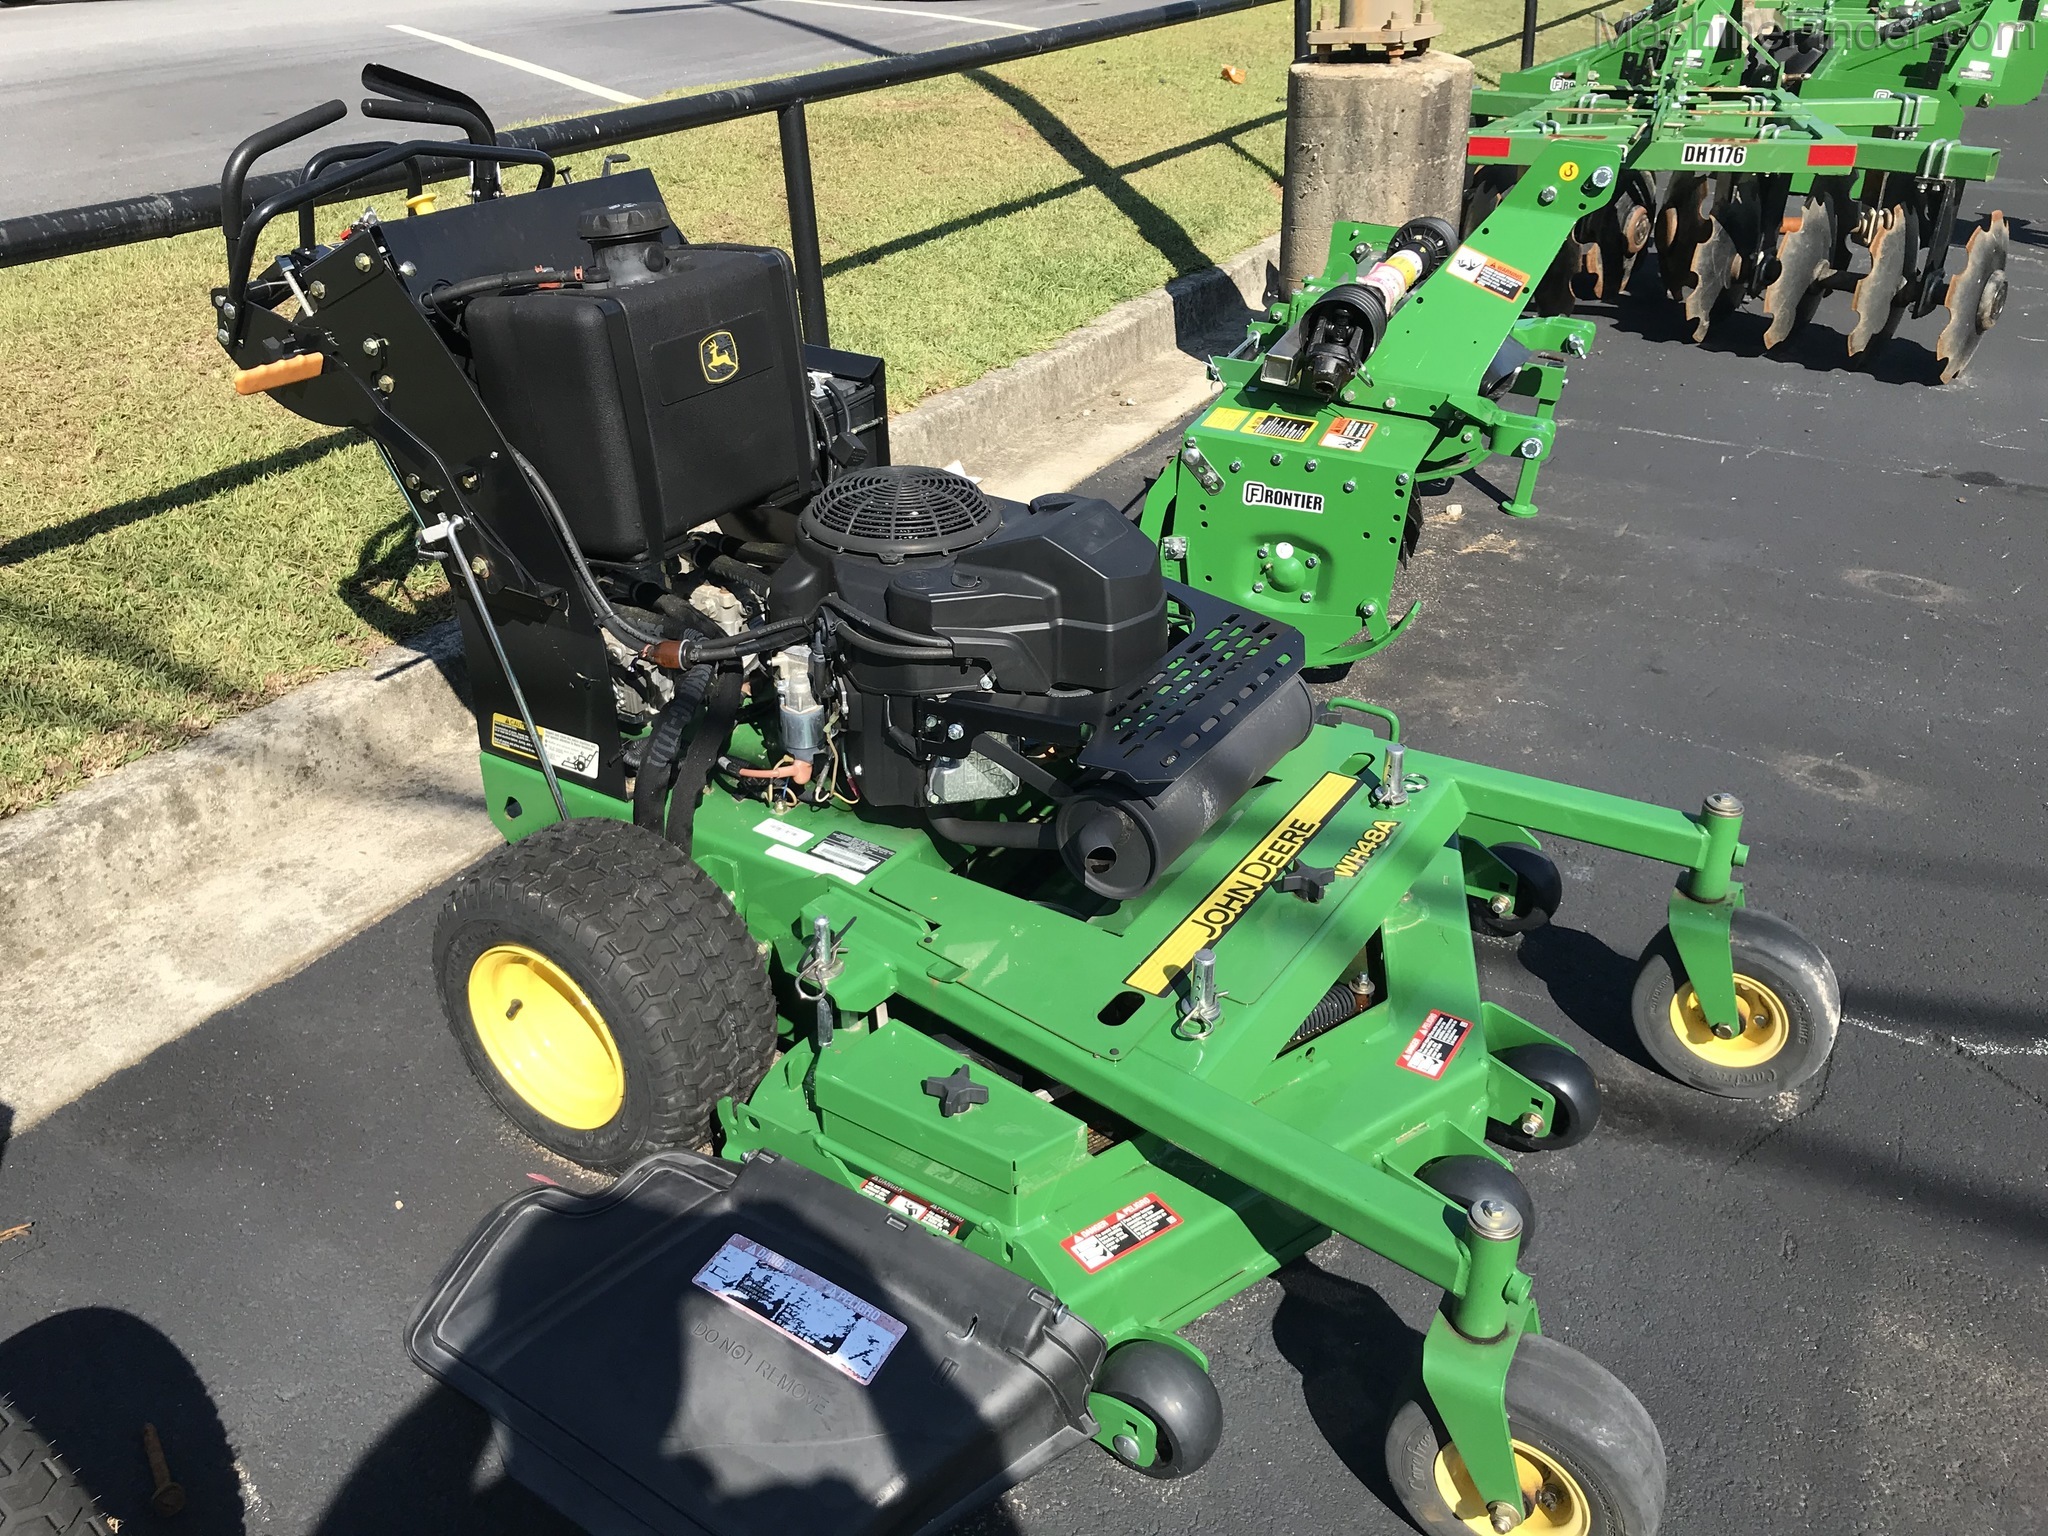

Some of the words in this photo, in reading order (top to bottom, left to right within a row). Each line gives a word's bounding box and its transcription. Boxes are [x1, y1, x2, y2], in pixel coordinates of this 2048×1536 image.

[1684, 146, 1745, 164] DH1176
[1245, 482, 1323, 511] FRONTIER
[1334, 819, 1402, 878] WH48A
[1191, 880, 1258, 938] JOHN
[1239, 818, 1315, 881] DEERE
[756, 1248, 796, 1274] DANGER
[836, 1291, 882, 1321] PELIGRO
[693, 1321, 720, 1344] DO
[720, 1336, 754, 1366] NOT
[755, 1359, 831, 1416] REMOVE
[1407, 1431, 1433, 1492] Carefree
